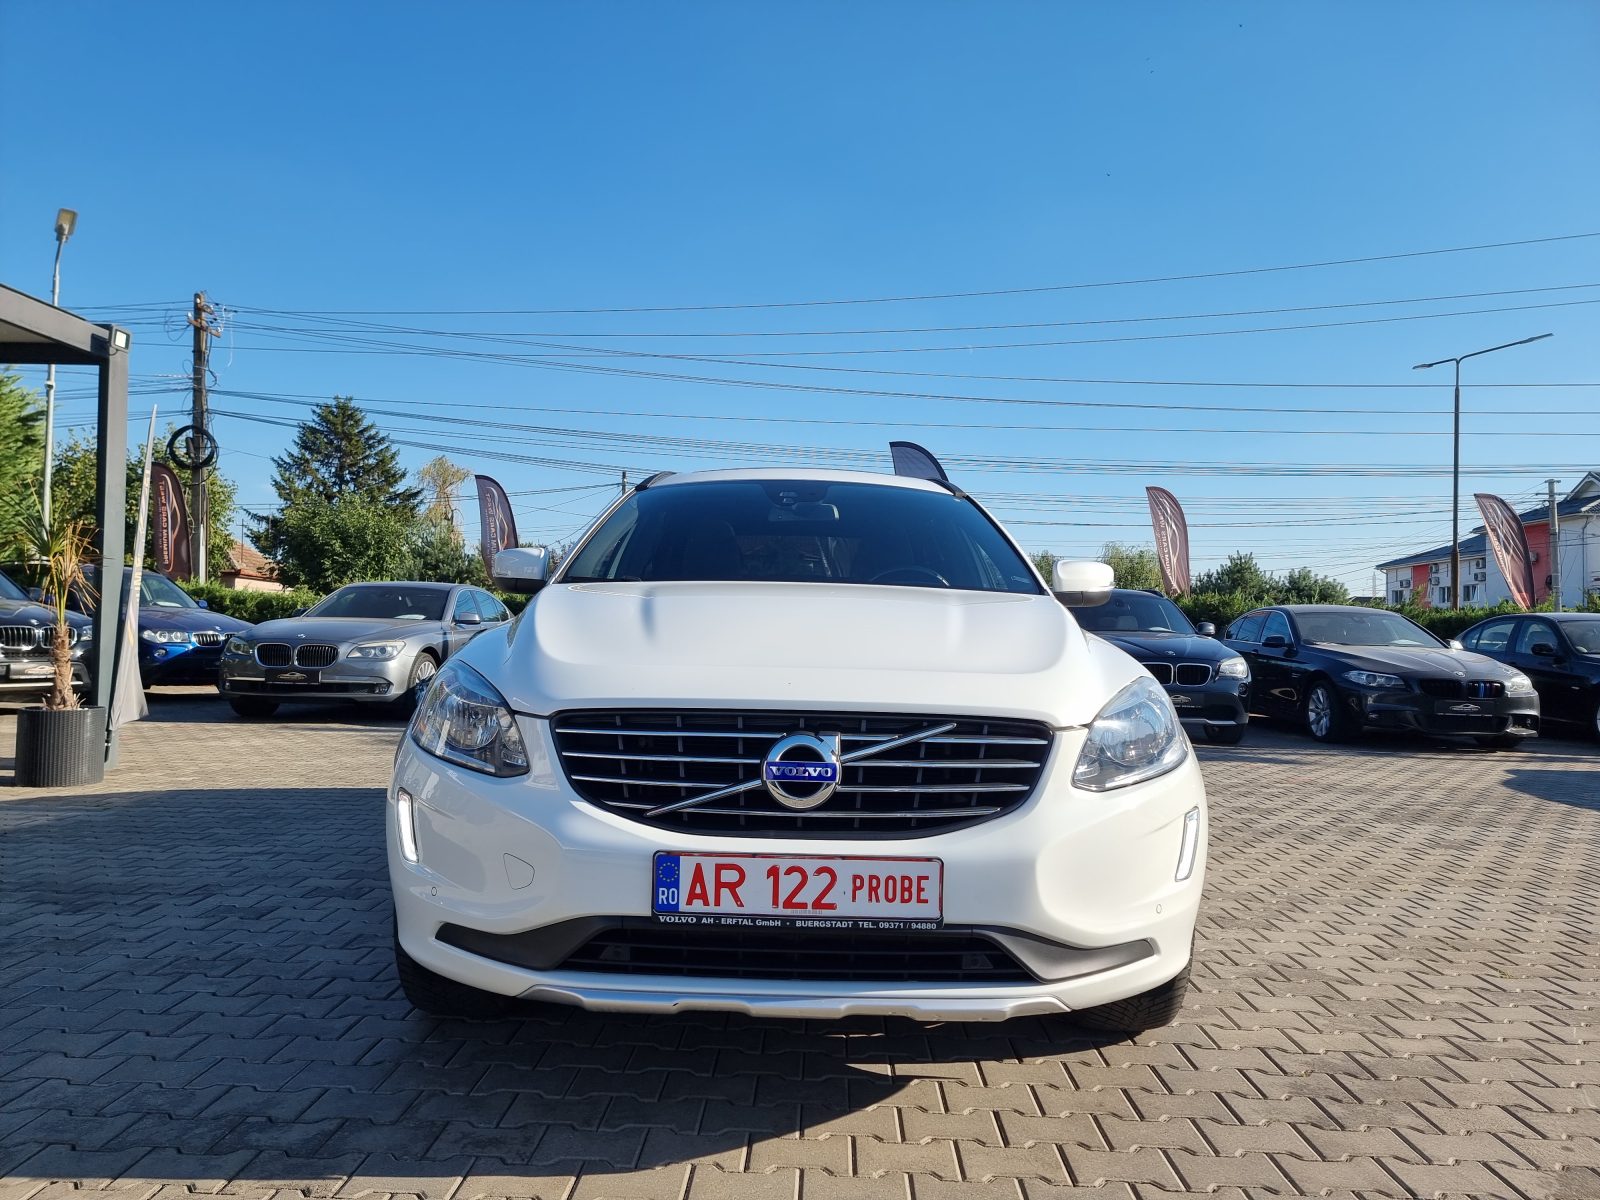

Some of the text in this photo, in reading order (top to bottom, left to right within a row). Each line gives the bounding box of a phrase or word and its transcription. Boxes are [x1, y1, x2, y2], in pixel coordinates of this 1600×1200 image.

[769, 766, 833, 777] VOLVO
[685, 862, 930, 910] AR 122 PROBE
[658, 887, 678, 905] RO
[658, 915, 697, 924] VOLVO
[721, 917, 754, 926] ERFTAL
[755, 919, 781, 927] GmbH
[795, 920, 854, 928] BUERGSTADT
[857, 921, 877, 929] TEL.
